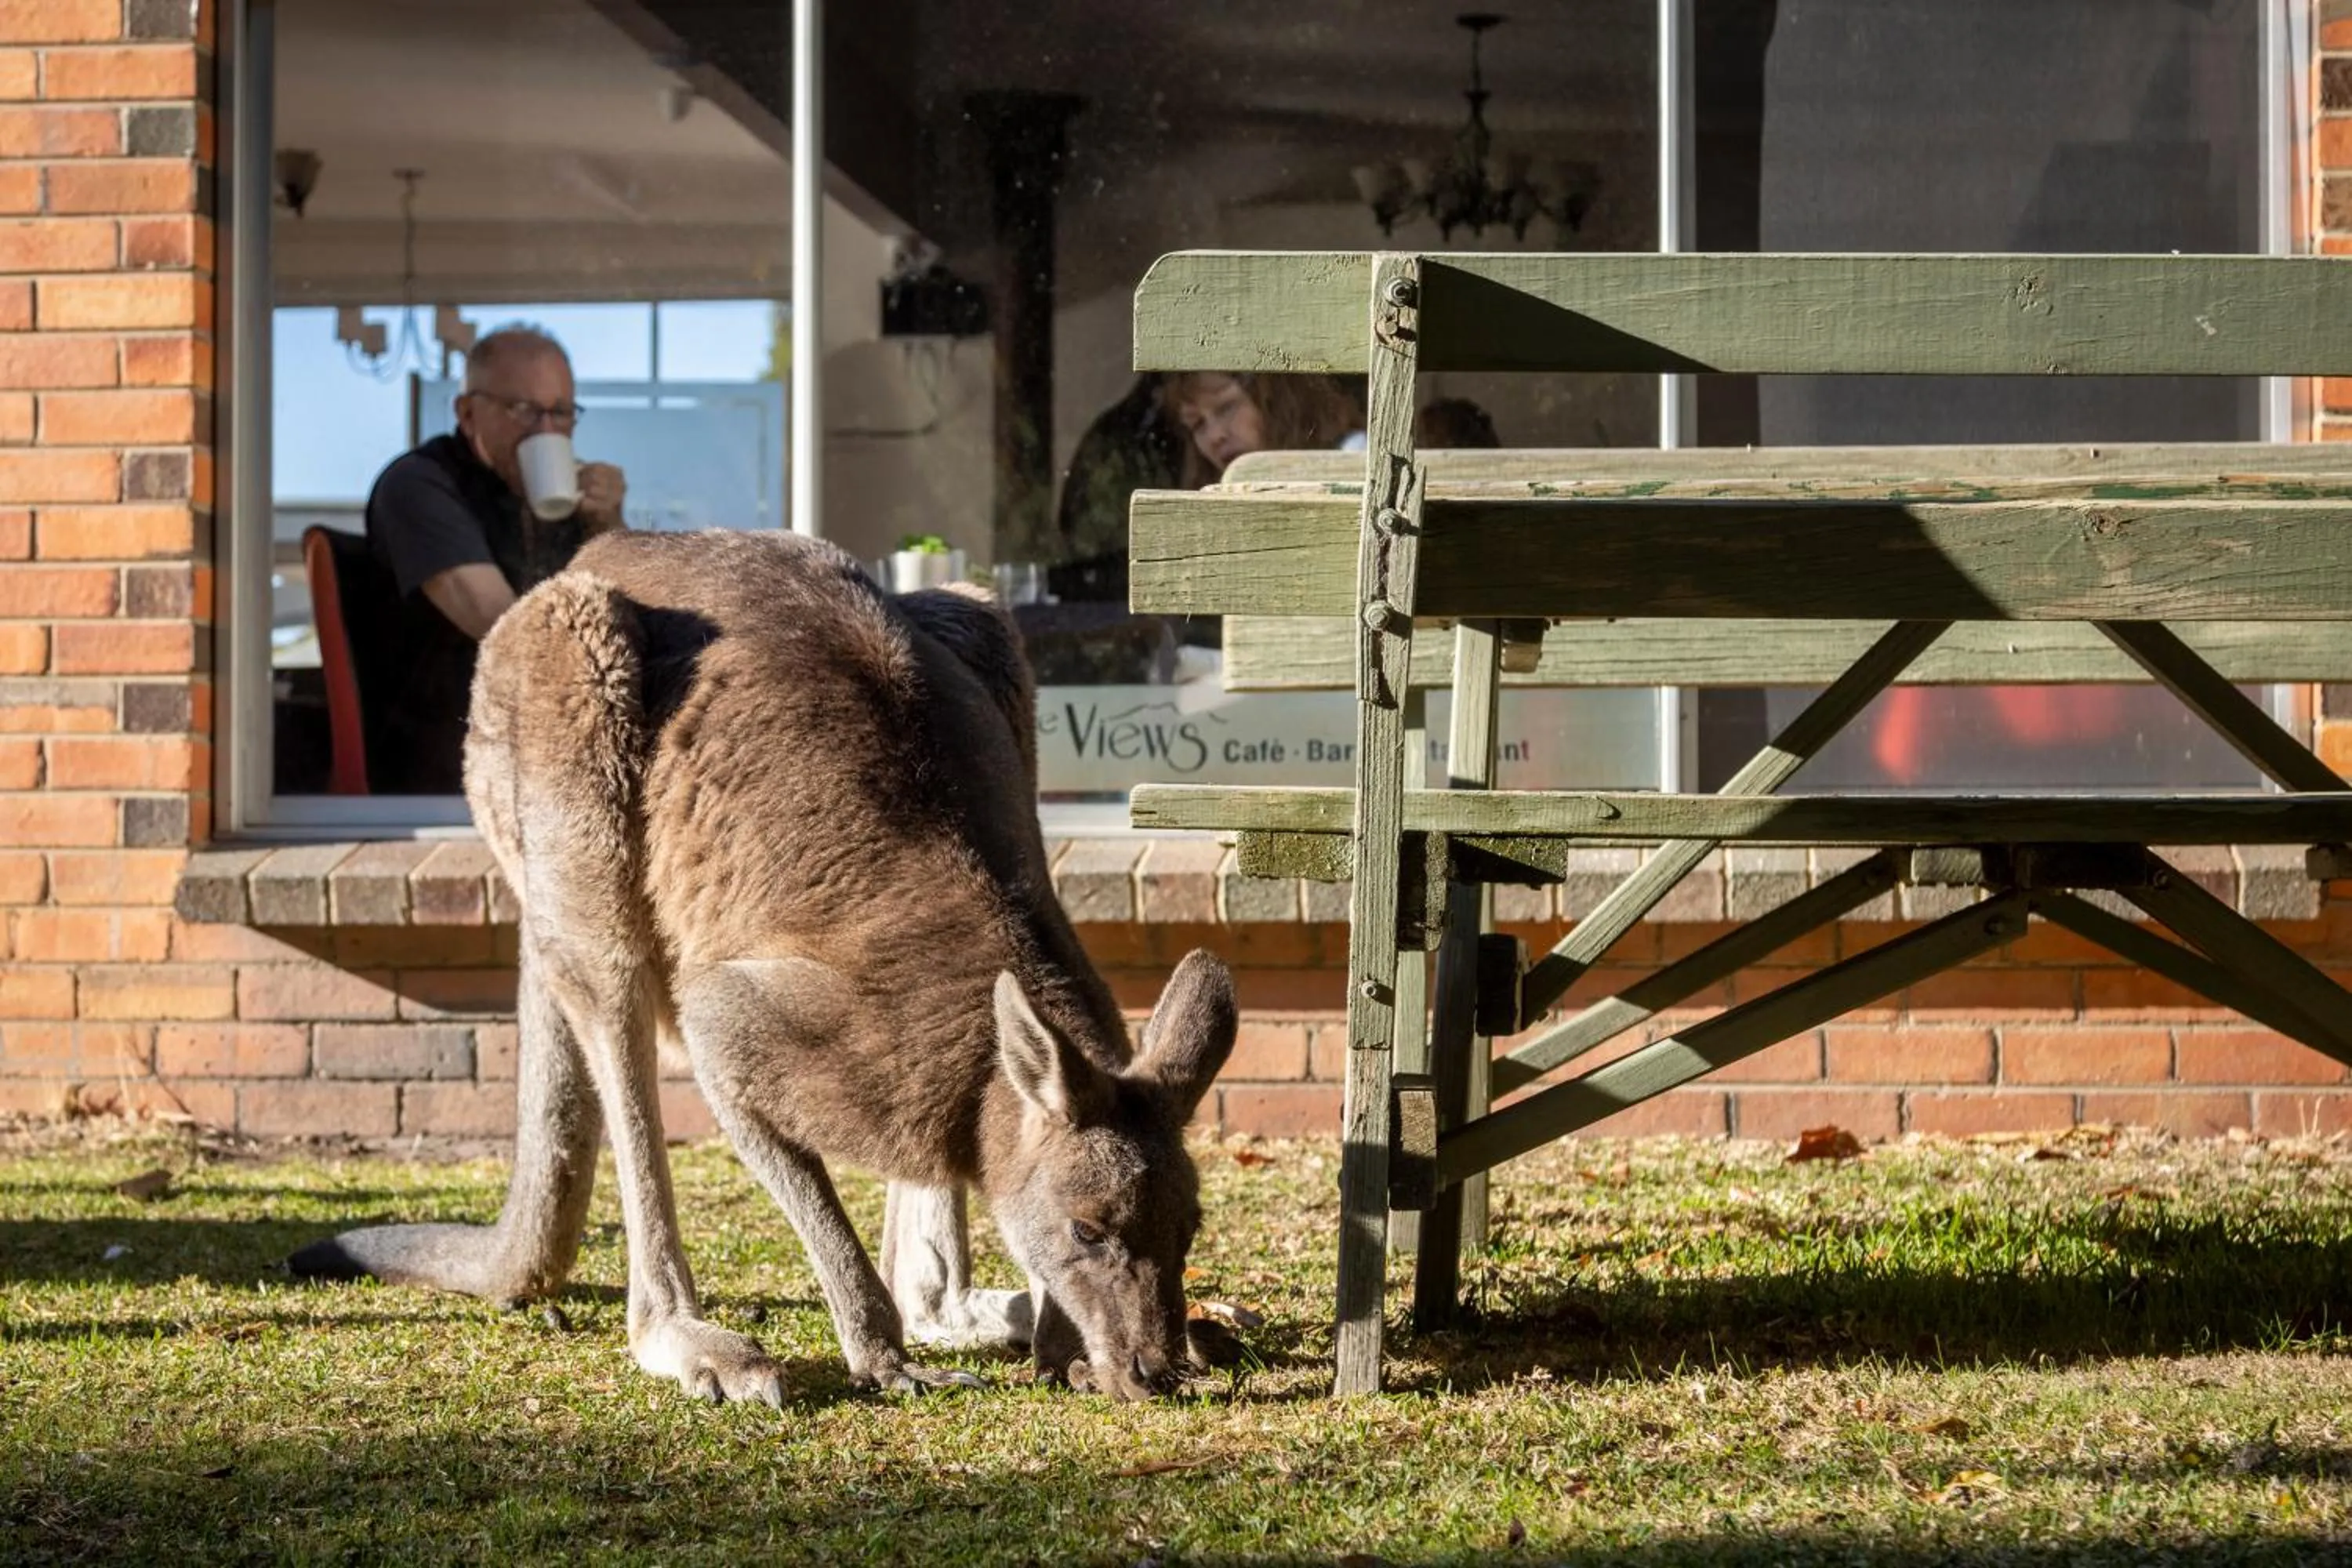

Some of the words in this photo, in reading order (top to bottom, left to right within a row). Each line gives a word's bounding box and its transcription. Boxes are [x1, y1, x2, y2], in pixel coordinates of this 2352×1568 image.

[1065, 702, 1208, 773] Views
[1223, 738, 1286, 764] Café
[1307, 739, 1355, 763] Bar
